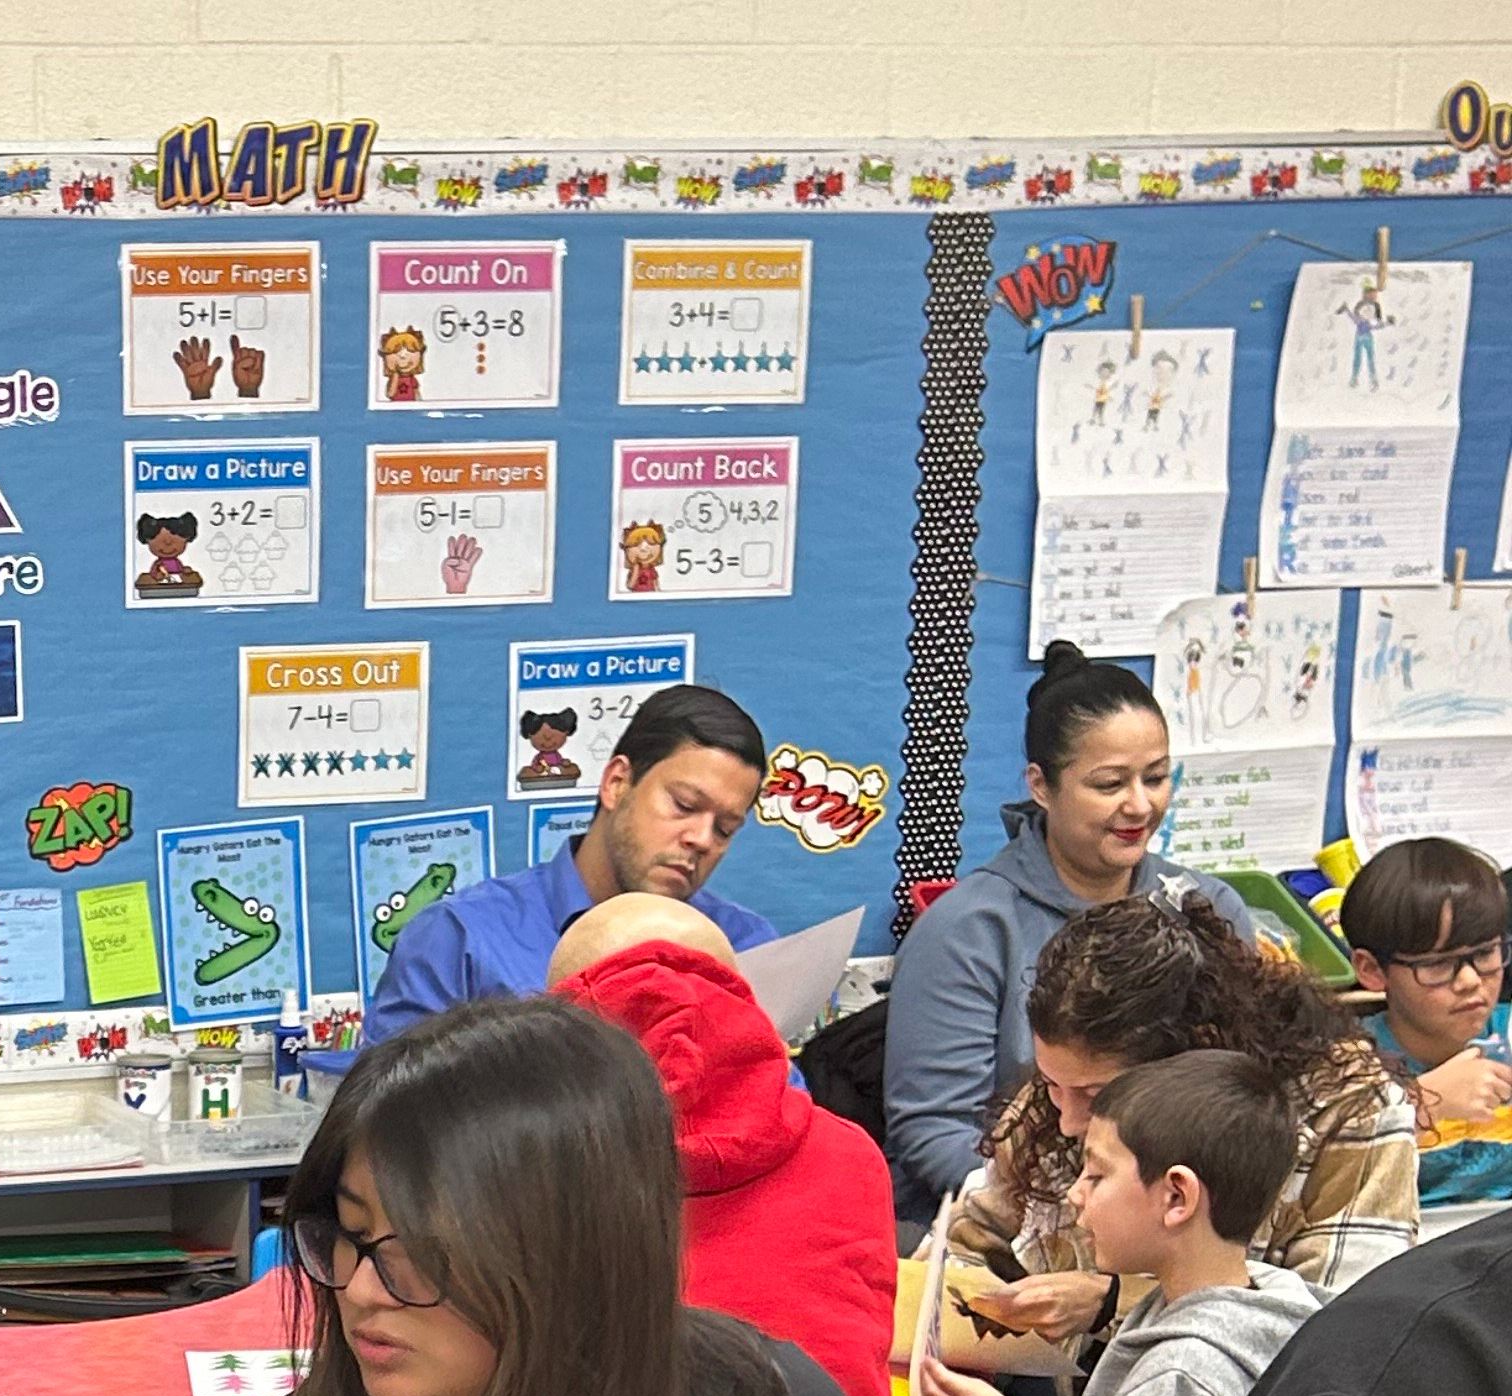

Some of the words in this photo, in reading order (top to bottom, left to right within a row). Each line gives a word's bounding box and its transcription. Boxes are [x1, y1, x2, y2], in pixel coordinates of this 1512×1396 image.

[156, 116, 378, 209] MATH
[133, 264, 170, 285] Use
[178, 264, 223, 285] Your
[231, 262, 309, 288] Fingers
[404, 259, 481, 286] Count
[491, 258, 528, 285] On
[634, 260, 718, 280] Combine
[724, 261, 737, 280] &
[744, 259, 799, 280] Count
[997, 241, 1110, 320] WOW
[138, 460, 198, 481] Draw
[205, 464, 219, 479] a
[226, 458, 306, 480] Picture
[376, 466, 413, 485] Use
[420, 465, 463, 484] Your
[471, 462, 544, 486] Fingers
[631, 456, 705, 482] Count
[714, 452, 778, 480] Back
[698, 503, 712, 524] 5
[266, 661, 343, 688] Cross
[352, 659, 401, 685] Out
[522, 660, 579, 681] Draw
[587, 662, 600, 677] a
[606, 655, 681, 676] Picture
[28, 786, 132, 855] ZAP!
[194, 991, 247, 1008] Greater
[252, 987, 281, 1001] than
[202, 1087, 229, 1119] H
